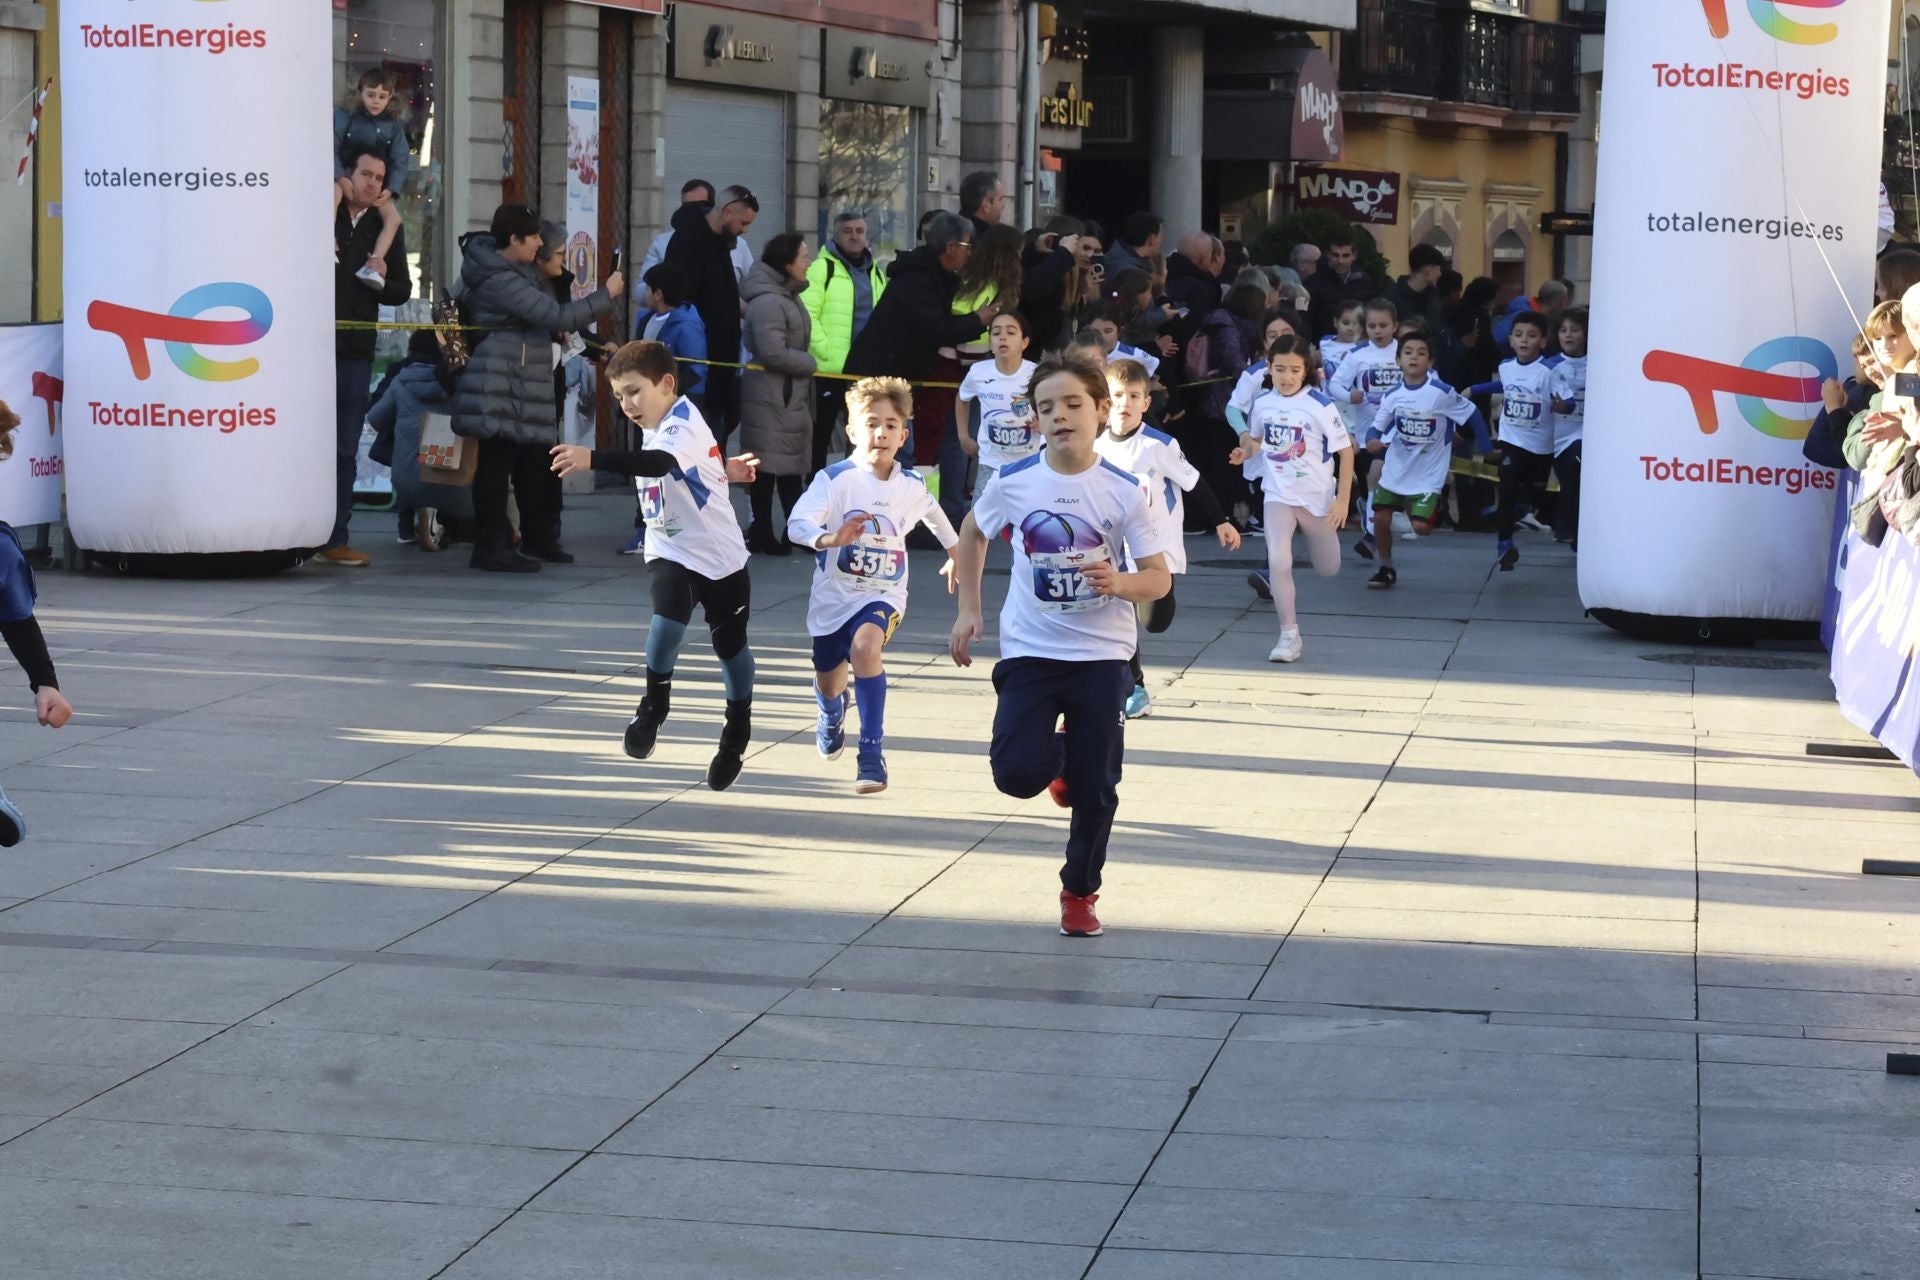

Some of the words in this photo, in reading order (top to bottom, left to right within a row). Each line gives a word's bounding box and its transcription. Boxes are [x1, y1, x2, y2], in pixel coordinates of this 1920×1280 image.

[81, 23, 267, 54] TotalEnergies
[1652, 63, 1850, 99] TotalEnergies
[84, 167, 270, 191] totalenergies.es
[1299, 174, 1383, 204] MUNDO
[1648, 212, 1843, 241] totalenergies.es
[88, 402, 276, 434] TotalEnergies
[1507, 401, 1534, 418] 3031
[993, 428, 1026, 444] 3082
[1401, 418, 1431, 435] 3655
[1640, 456, 1836, 494] TotalEnergies
[849, 549, 897, 577] 3315
